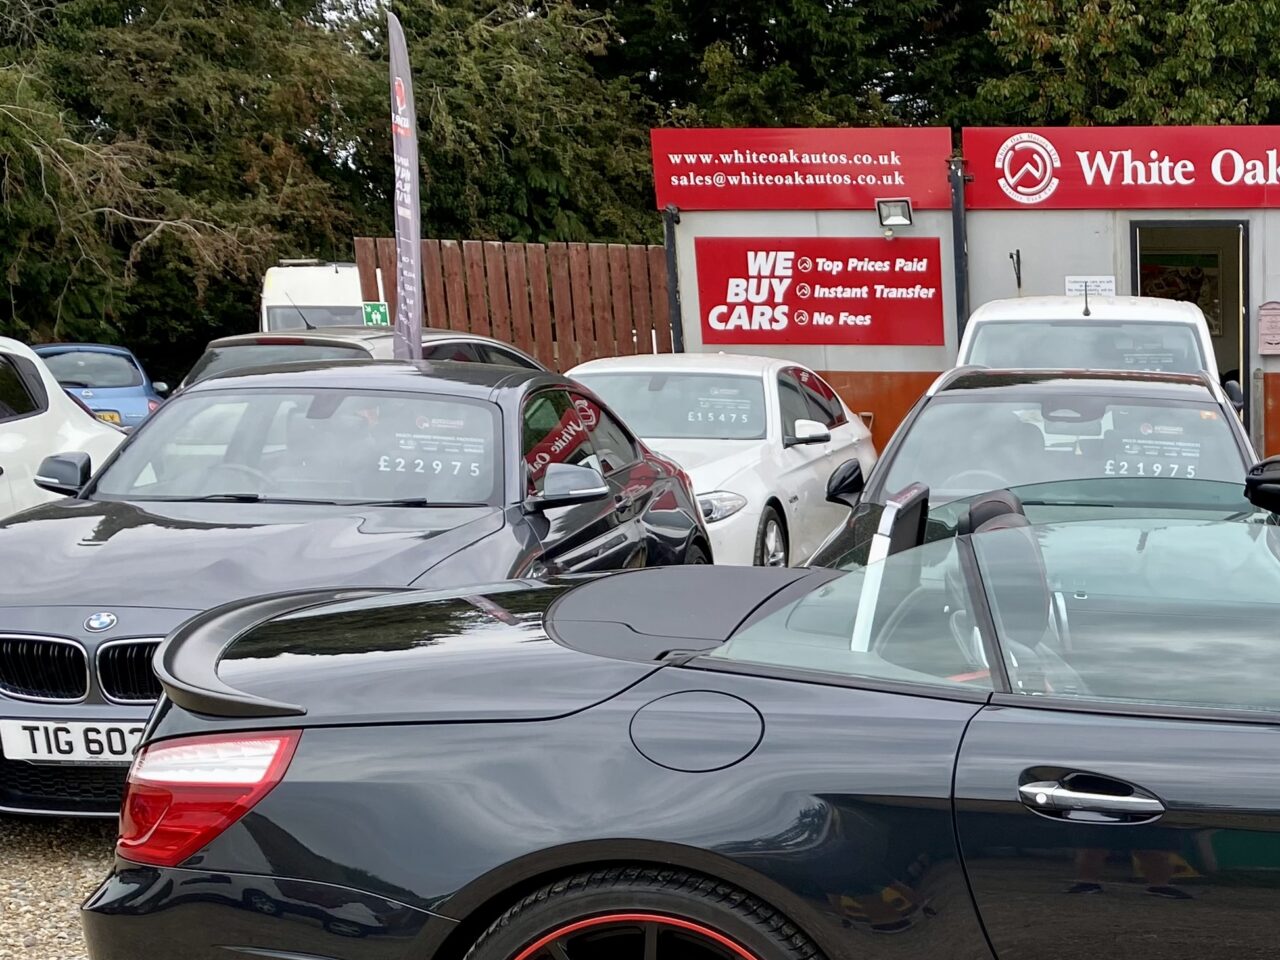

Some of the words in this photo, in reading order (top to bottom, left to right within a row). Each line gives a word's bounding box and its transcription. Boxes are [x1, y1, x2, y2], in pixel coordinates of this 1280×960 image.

[668, 148, 902, 165] www.whiteoakautos.co.uk
[1076, 149, 1196, 186] White
[670, 170, 905, 187] sales@whiteoakautos.co.uk
[747, 251, 795, 277] WE
[815, 257, 843, 275] Top
[847, 257, 891, 272] Prices
[894, 257, 928, 272] Paid
[727, 277, 793, 304] BUY
[813, 284, 869, 299] Instant
[873, 284, 936, 299] Transfer
[708, 305, 789, 331] CARS
[812, 311, 834, 326] No
[838, 311, 872, 326] Fees
[378, 455, 480, 477] £22975
[1104, 460, 1196, 478] £21975
[21, 725, 74, 755] TIG
